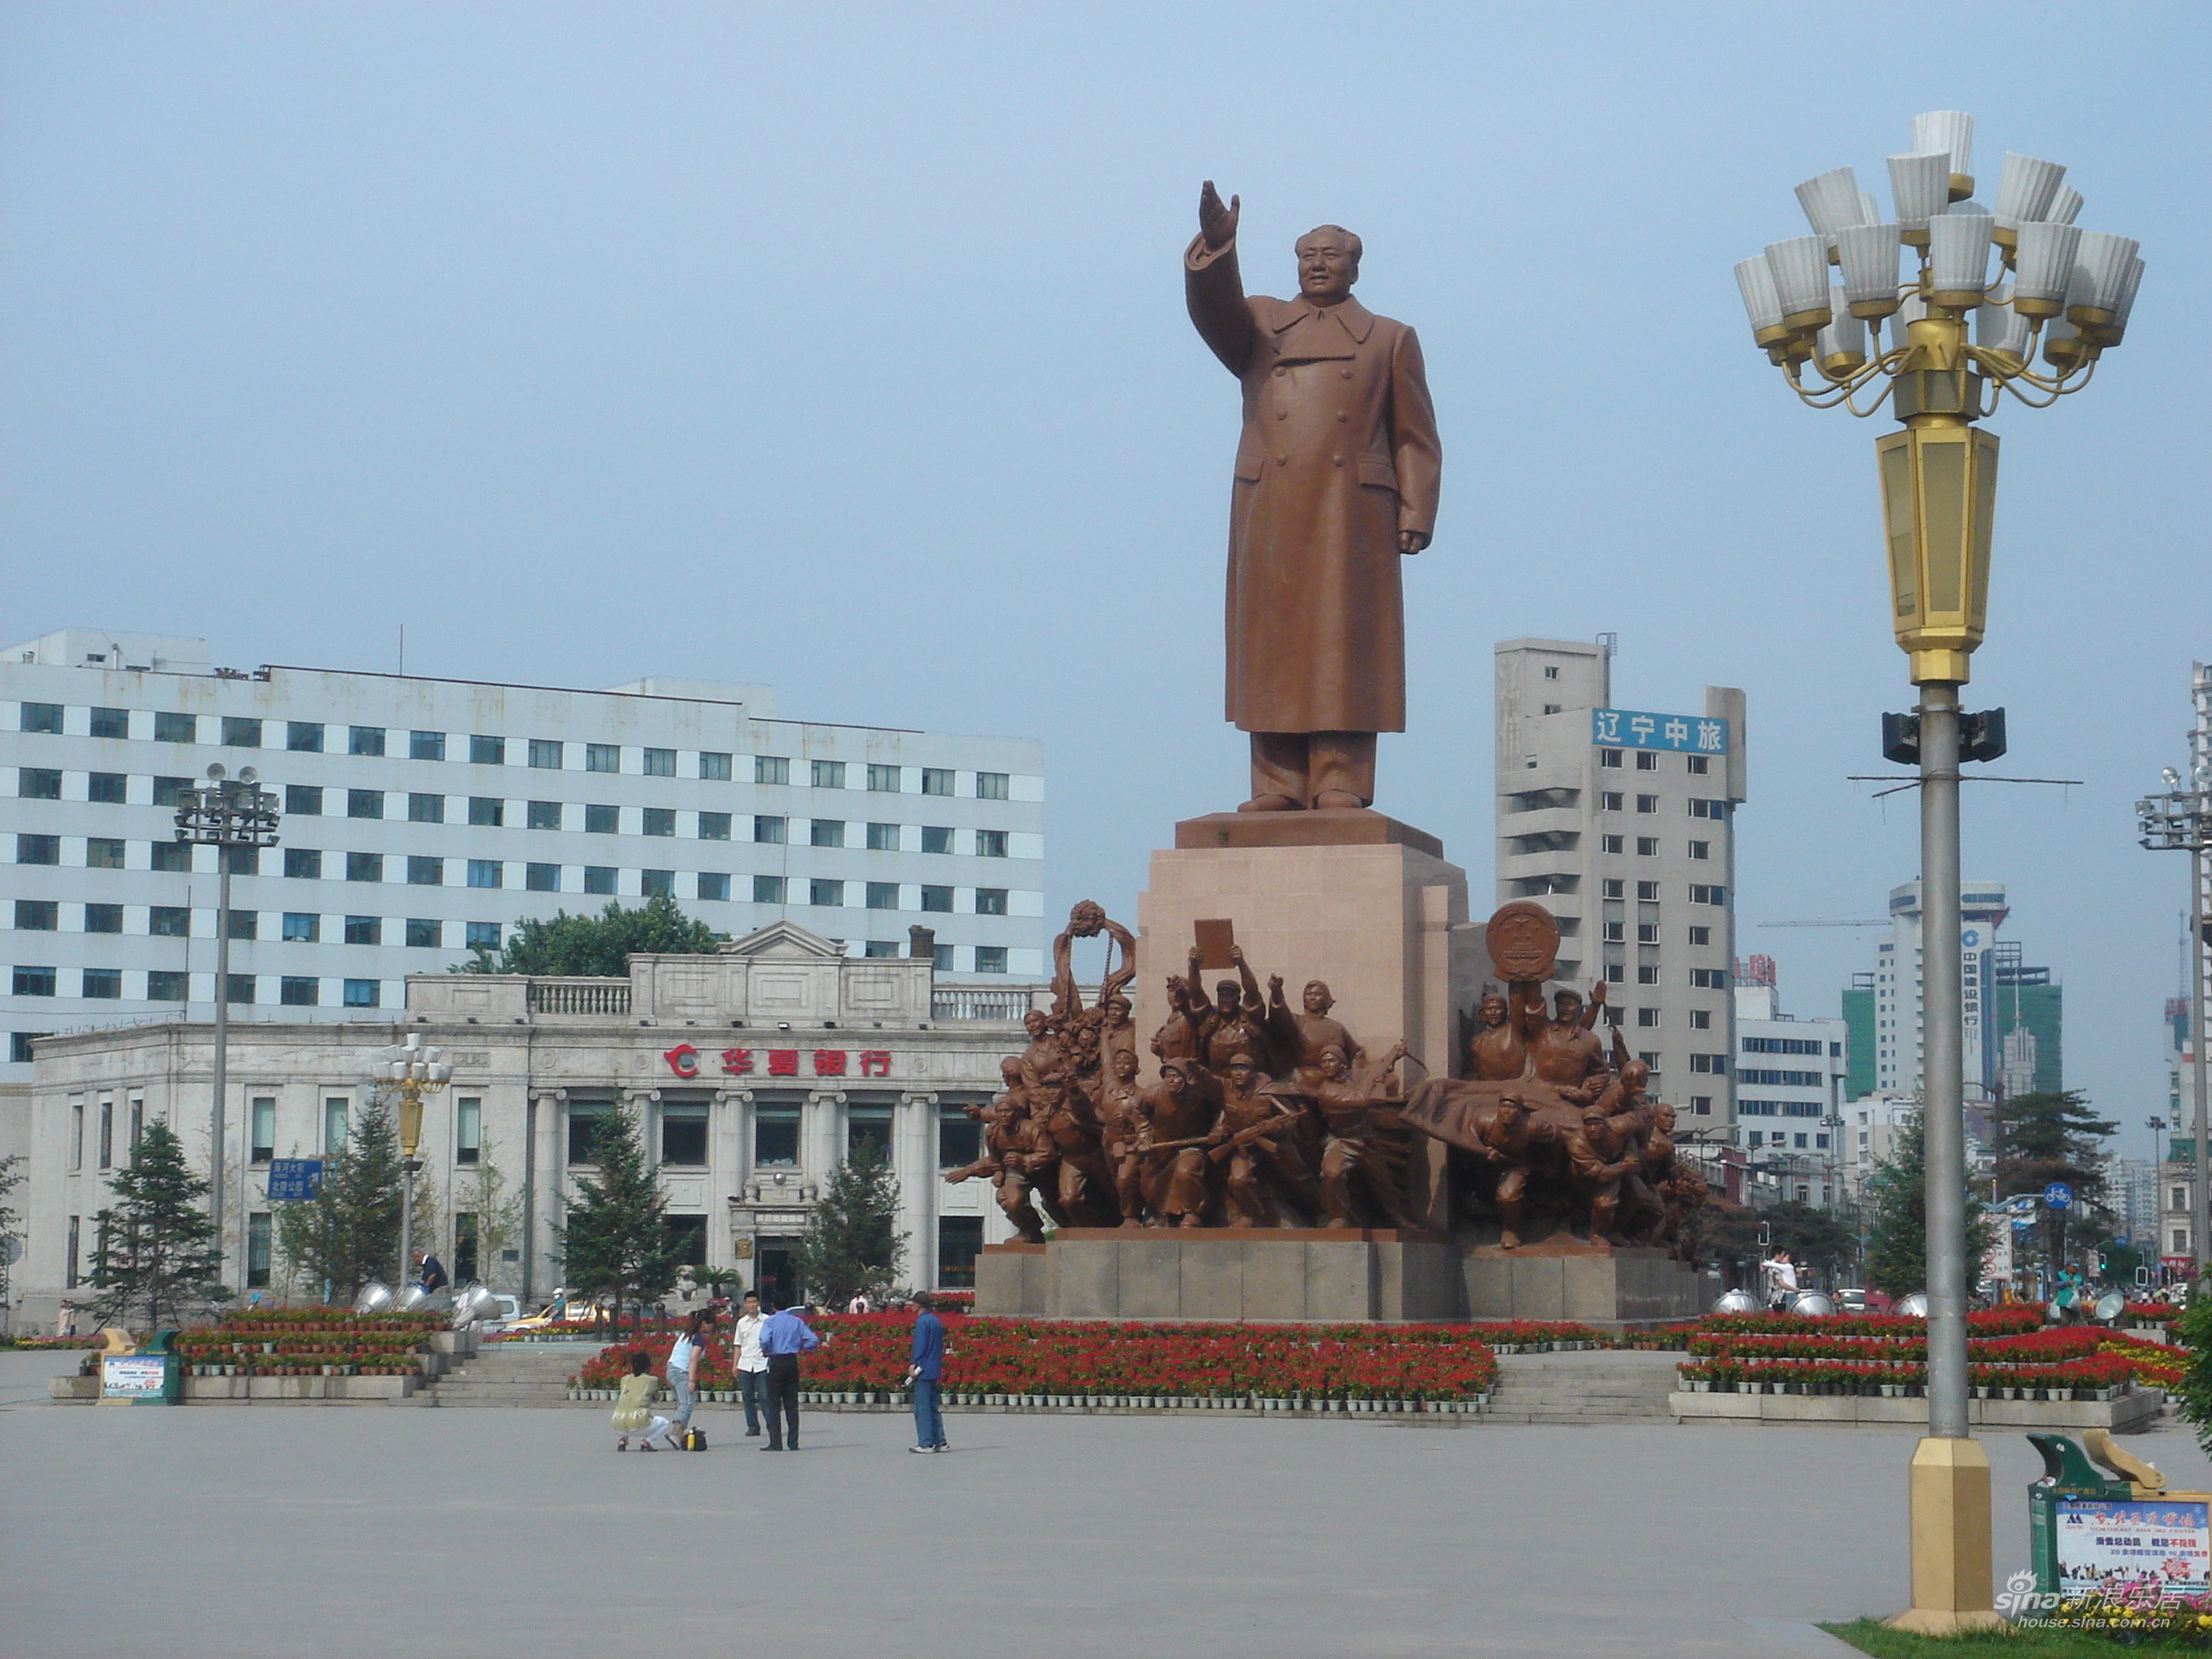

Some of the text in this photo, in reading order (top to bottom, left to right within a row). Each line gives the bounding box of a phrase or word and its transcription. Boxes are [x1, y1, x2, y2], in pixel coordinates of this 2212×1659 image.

[1597, 712, 1722, 751] 辽宁中旅
[1964, 952, 1978, 1026] 中国建设银行
[721, 1048, 891, 1076] 华夏银行
